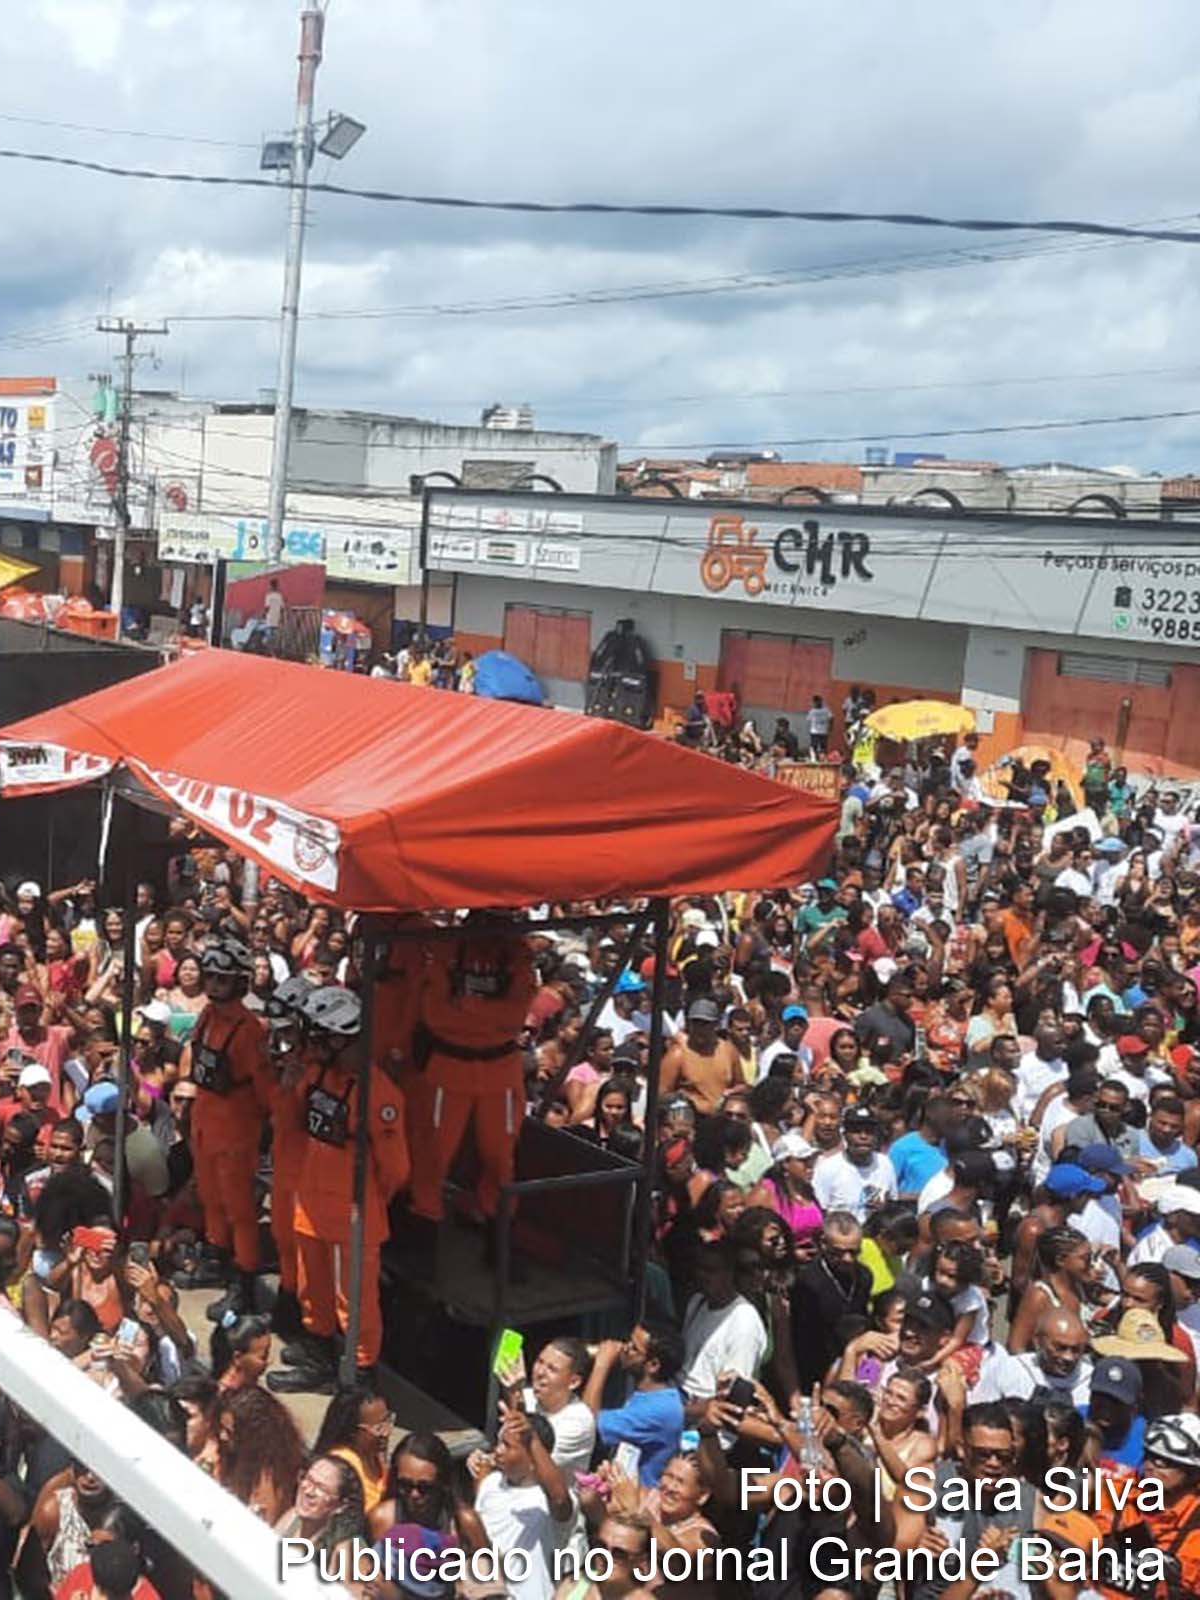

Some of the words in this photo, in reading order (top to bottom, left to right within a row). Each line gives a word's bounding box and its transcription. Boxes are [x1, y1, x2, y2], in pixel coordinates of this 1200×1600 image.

[774, 521, 874, 586] CHR
[1111, 557, 1182, 578] serviços
[228, 789, 278, 844] 02
